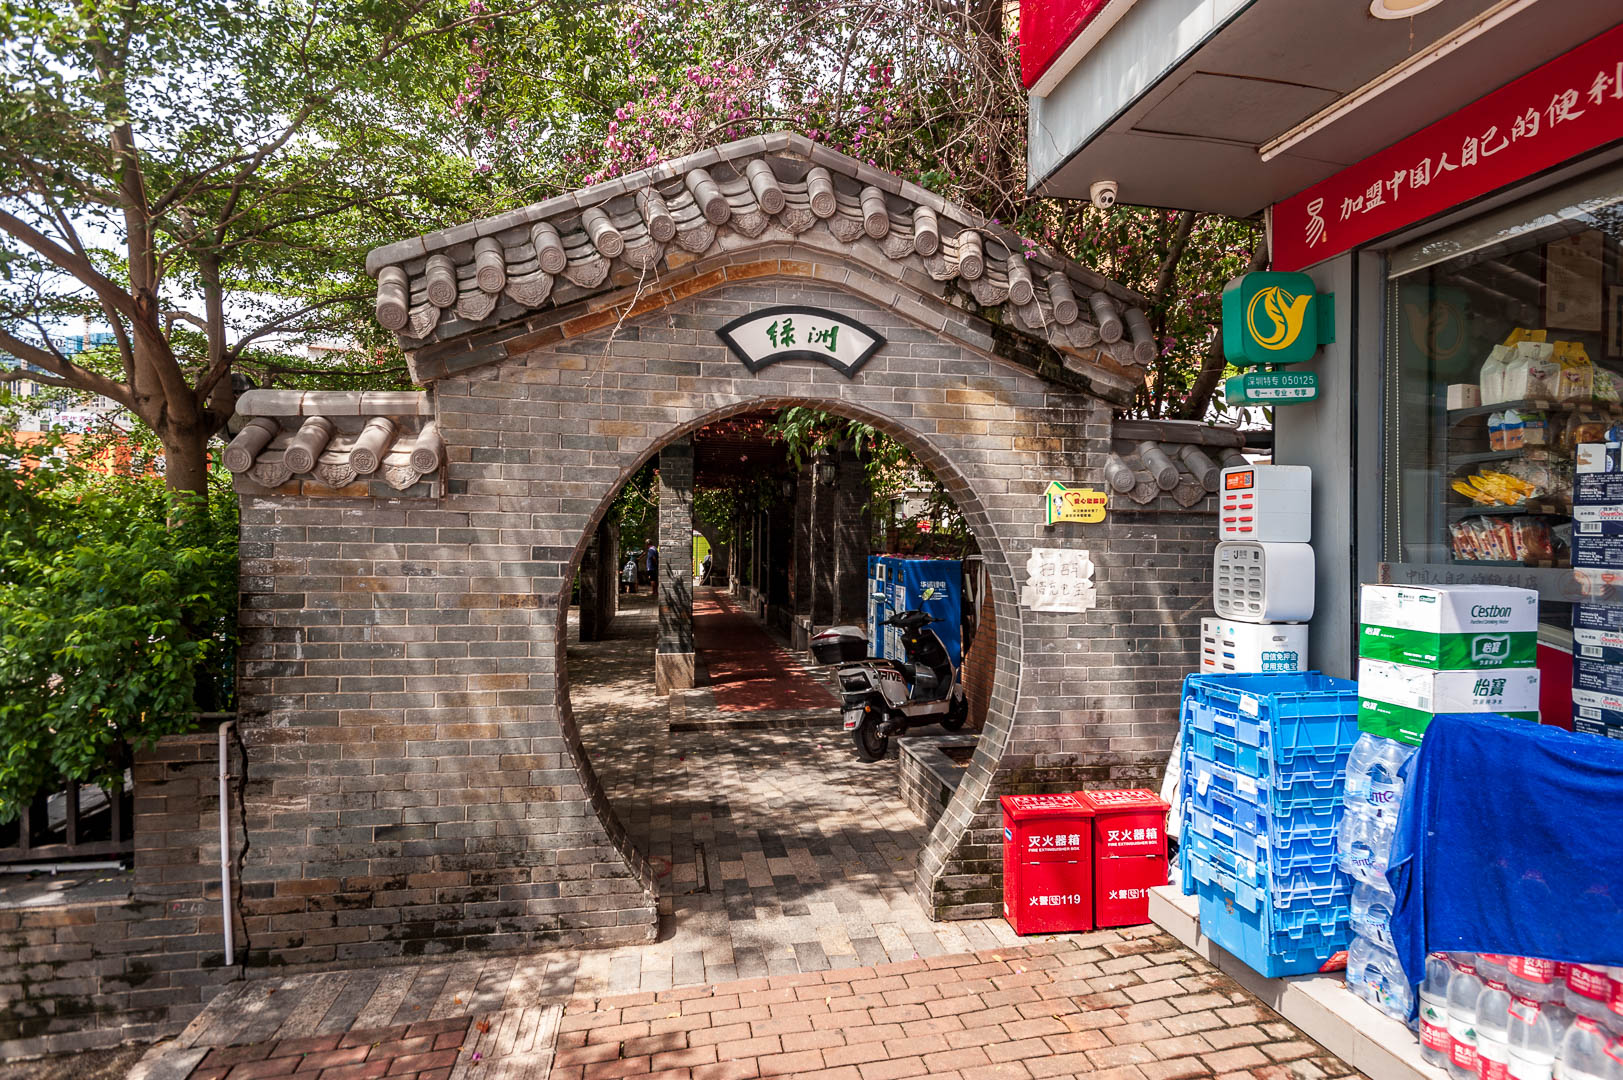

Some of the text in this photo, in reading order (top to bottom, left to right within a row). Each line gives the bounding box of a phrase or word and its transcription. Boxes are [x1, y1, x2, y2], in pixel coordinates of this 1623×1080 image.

[1340, 62, 1623, 221] 加盟中国人自己的便利
[766, 318, 839, 352] 绿洲
[1281, 375, 1314, 385] 050125
[1028, 833, 1080, 848] 灭火器箱
[1108, 827, 1158, 842] 灭火器箱
[1029, 893, 1081, 906] 火警 119
[1108, 889, 1128, 900] 火警
